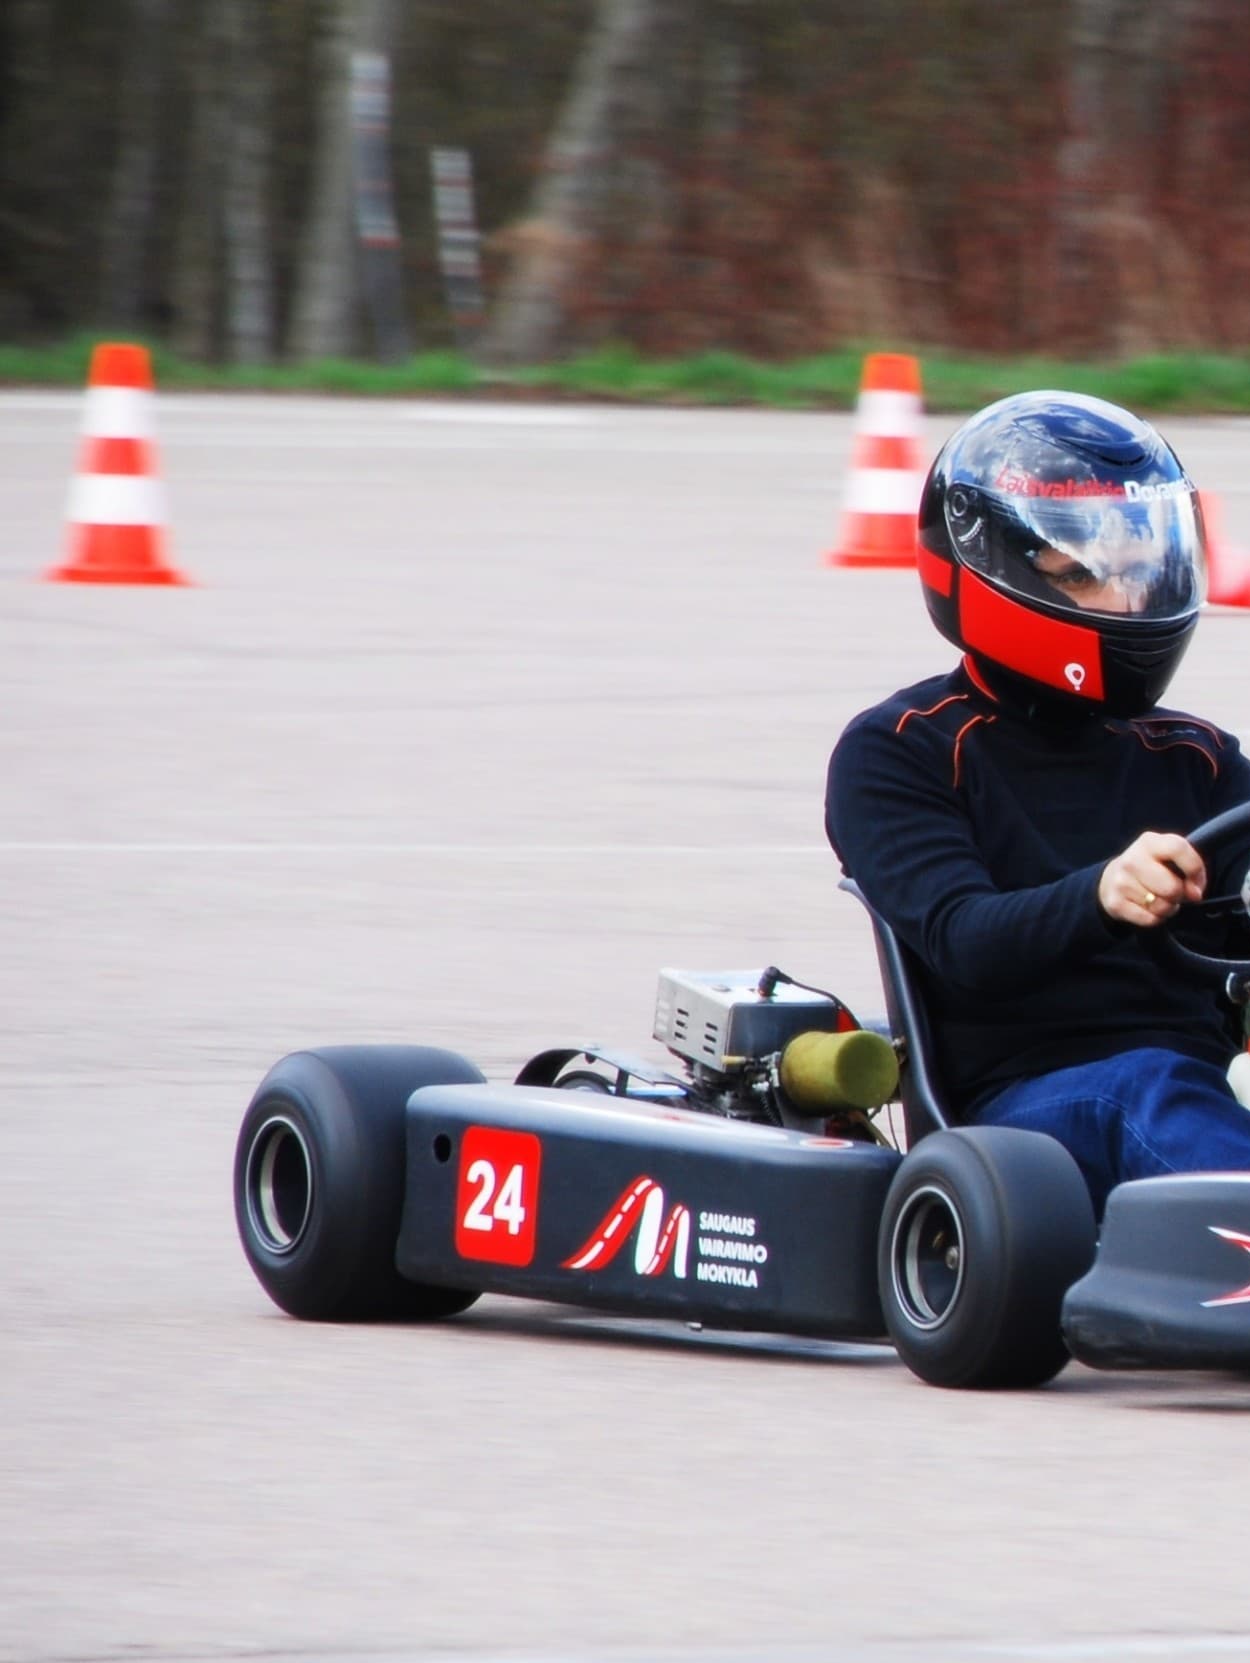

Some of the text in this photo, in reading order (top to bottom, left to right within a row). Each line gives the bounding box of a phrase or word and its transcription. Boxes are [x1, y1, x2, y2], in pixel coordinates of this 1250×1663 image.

[463, 1159, 525, 1235] 24
[699, 1211, 756, 1236] SAUGAUS
[698, 1236, 768, 1264] VAIRAVIMO
[697, 1262, 758, 1289] MOKYKLA
